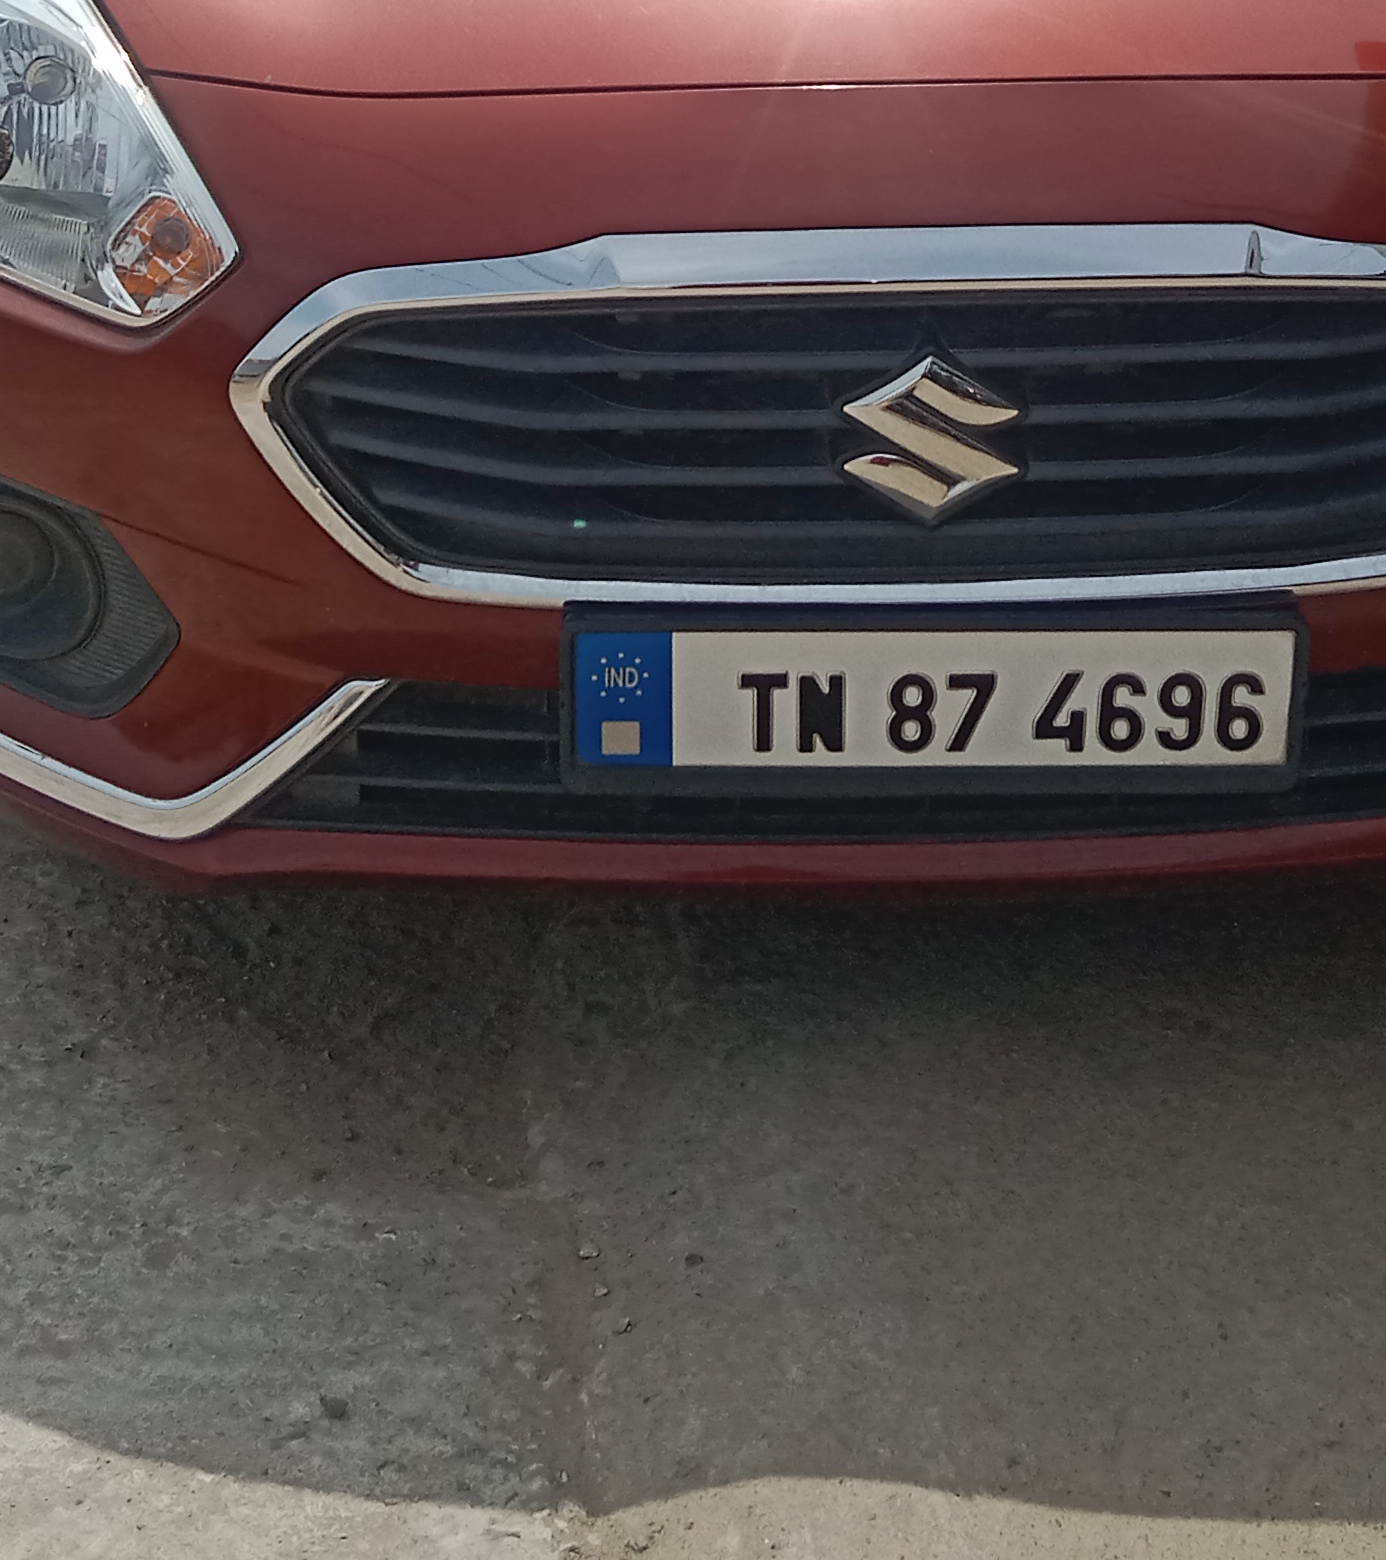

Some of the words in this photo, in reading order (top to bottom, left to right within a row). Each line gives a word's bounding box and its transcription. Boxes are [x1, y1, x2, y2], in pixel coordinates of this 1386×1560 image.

[604, 667, 640, 689] IND
[737, 670, 846, 754] TN
[886, 670, 998, 754] 87
[1031, 669, 1268, 754] 4696
